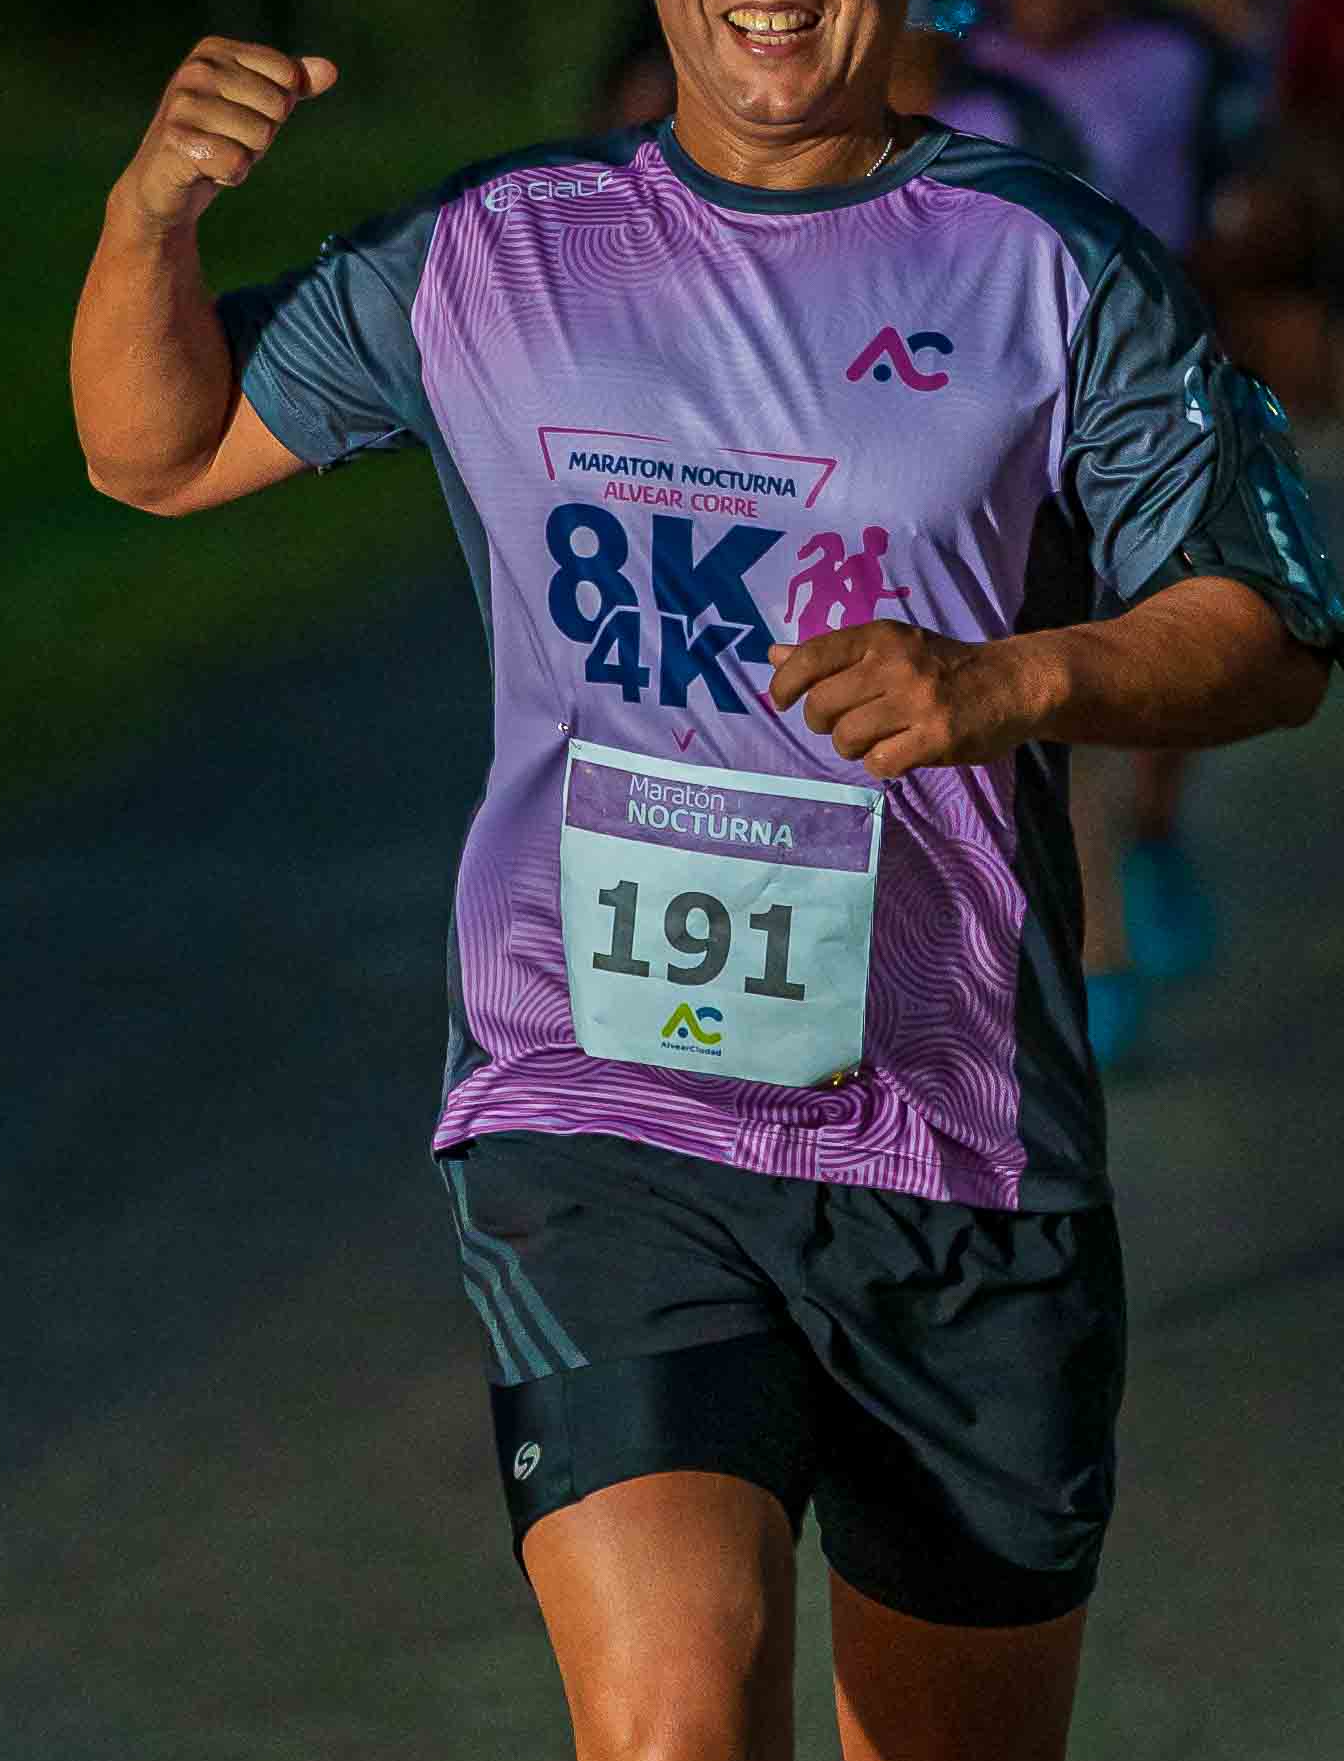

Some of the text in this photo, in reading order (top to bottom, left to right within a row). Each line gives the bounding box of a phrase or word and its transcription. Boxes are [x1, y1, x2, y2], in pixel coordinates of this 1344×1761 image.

[568, 451, 797, 498] MARATON NOCTURNA
[603, 481, 759, 519] ALVEAR CORRE
[545, 502, 788, 665] 8K
[585, 609, 752, 715] 4K
[628, 774, 725, 811] Maratón
[627, 799, 794, 849] NOCTURNA
[592, 879, 806, 1001] 191
